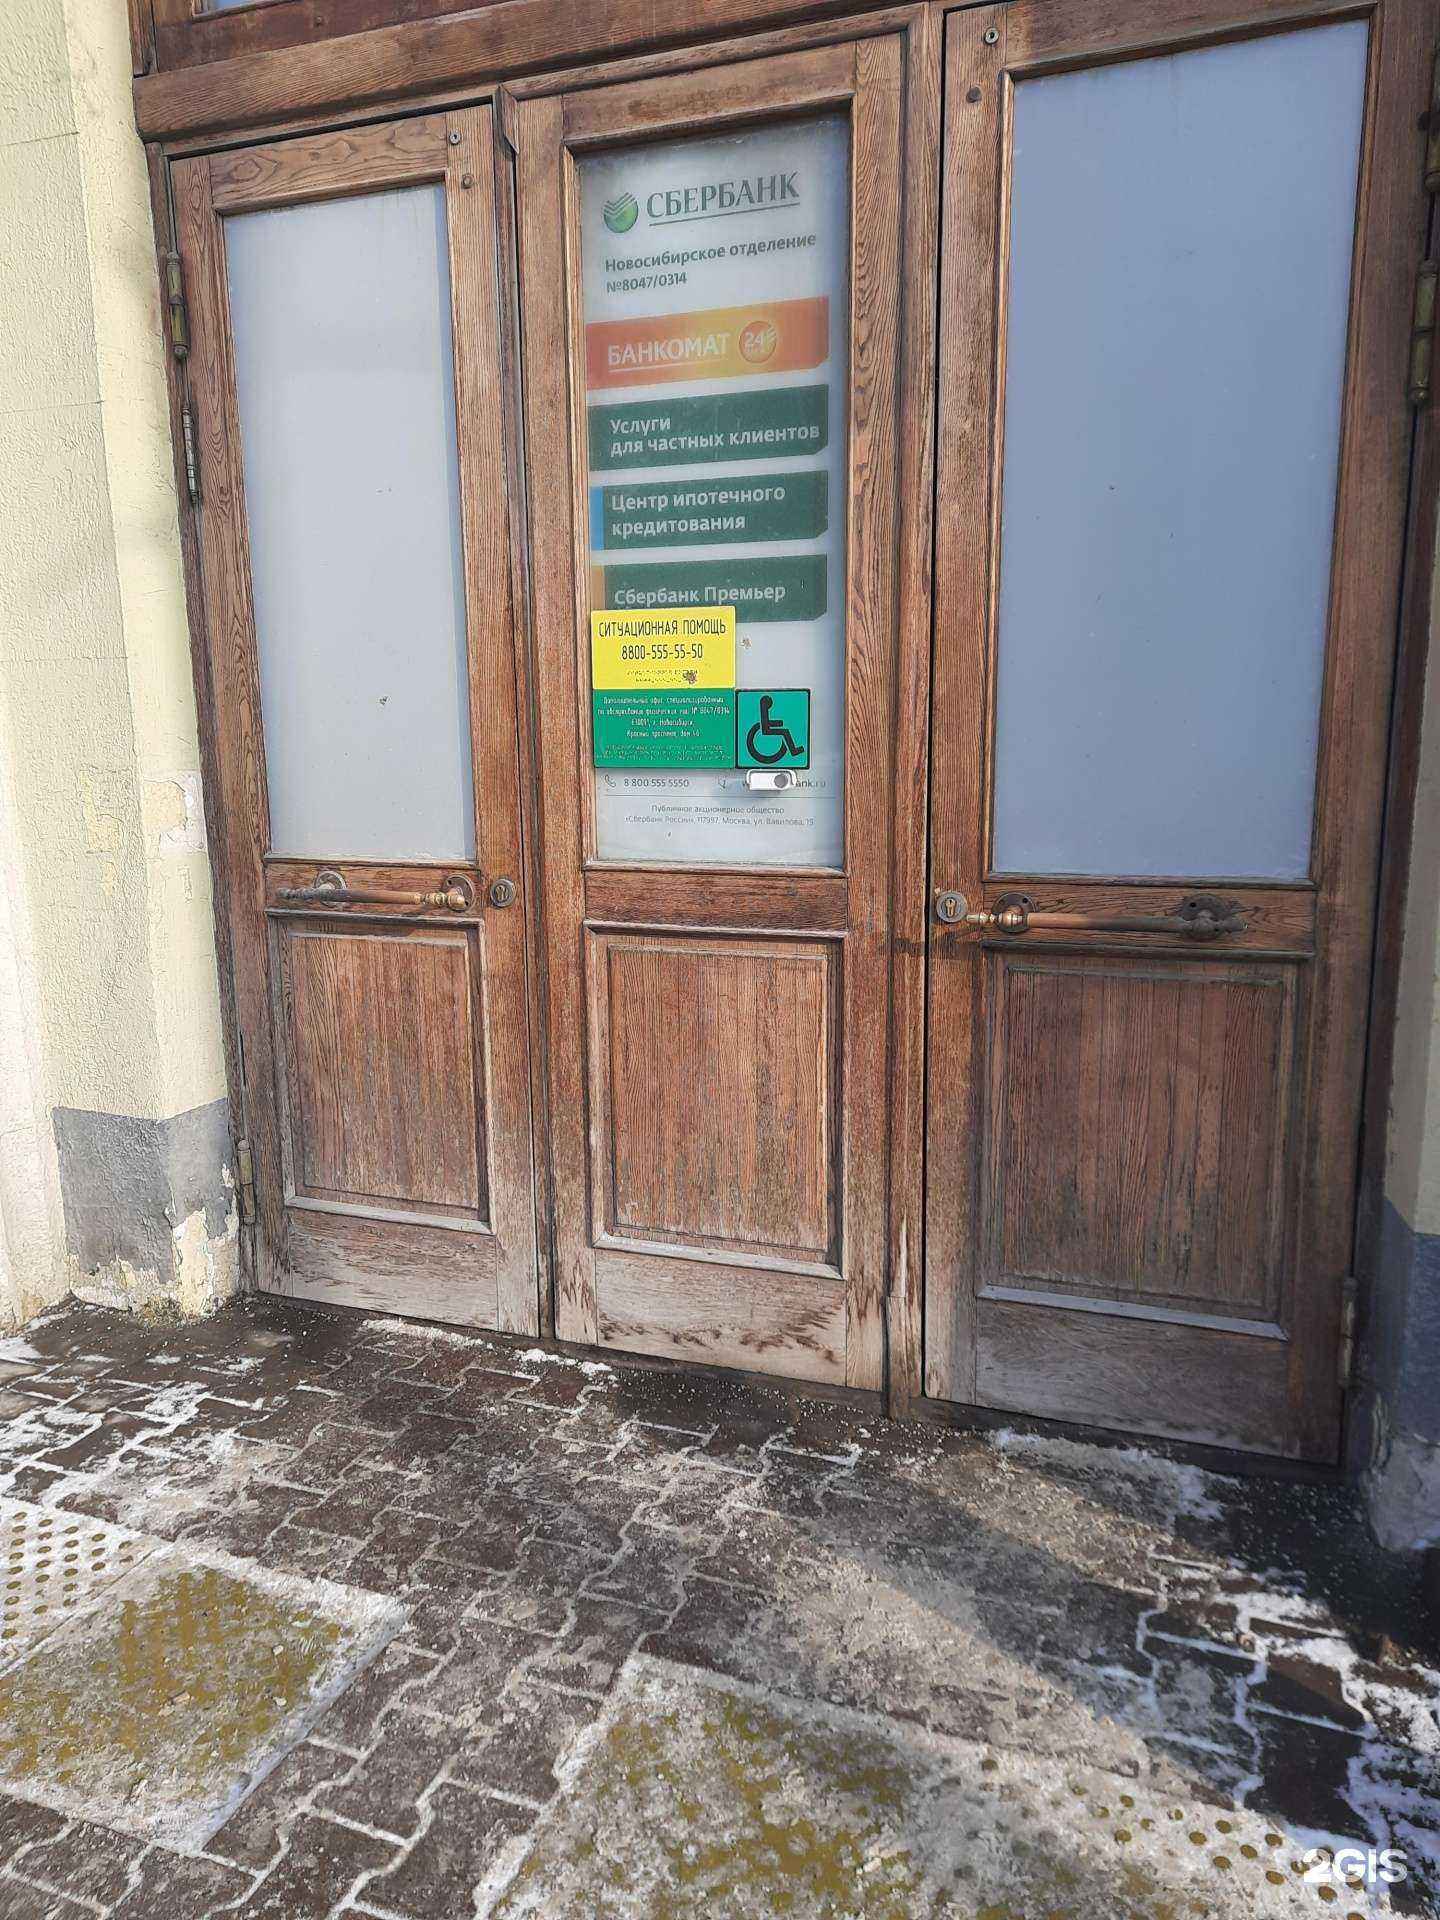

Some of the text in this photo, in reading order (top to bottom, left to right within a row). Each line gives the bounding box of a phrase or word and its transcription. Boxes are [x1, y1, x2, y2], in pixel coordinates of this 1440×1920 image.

[647, 171, 800, 219] СБЕРБАНК
[605, 233, 816, 273] Новосибирское отделение
[606, 271, 687, 294] №8047/0314
[607, 332, 730, 366] БАНКОМАТ
[610, 416, 671, 436] Услуги
[610, 424, 820, 458] для частных клиентов
[612, 486, 786, 512] Центр ипотечного
[612, 515, 746, 540] кредитования
[614, 585, 786, 607] Сбербанк Премьер
[598, 619, 726, 638] СИТУАЦИОННАЯ ПОМОЩЬ
[621, 643, 704, 661] 8800-555-55-50
[624, 778, 689, 788] 8 800 555 5550
